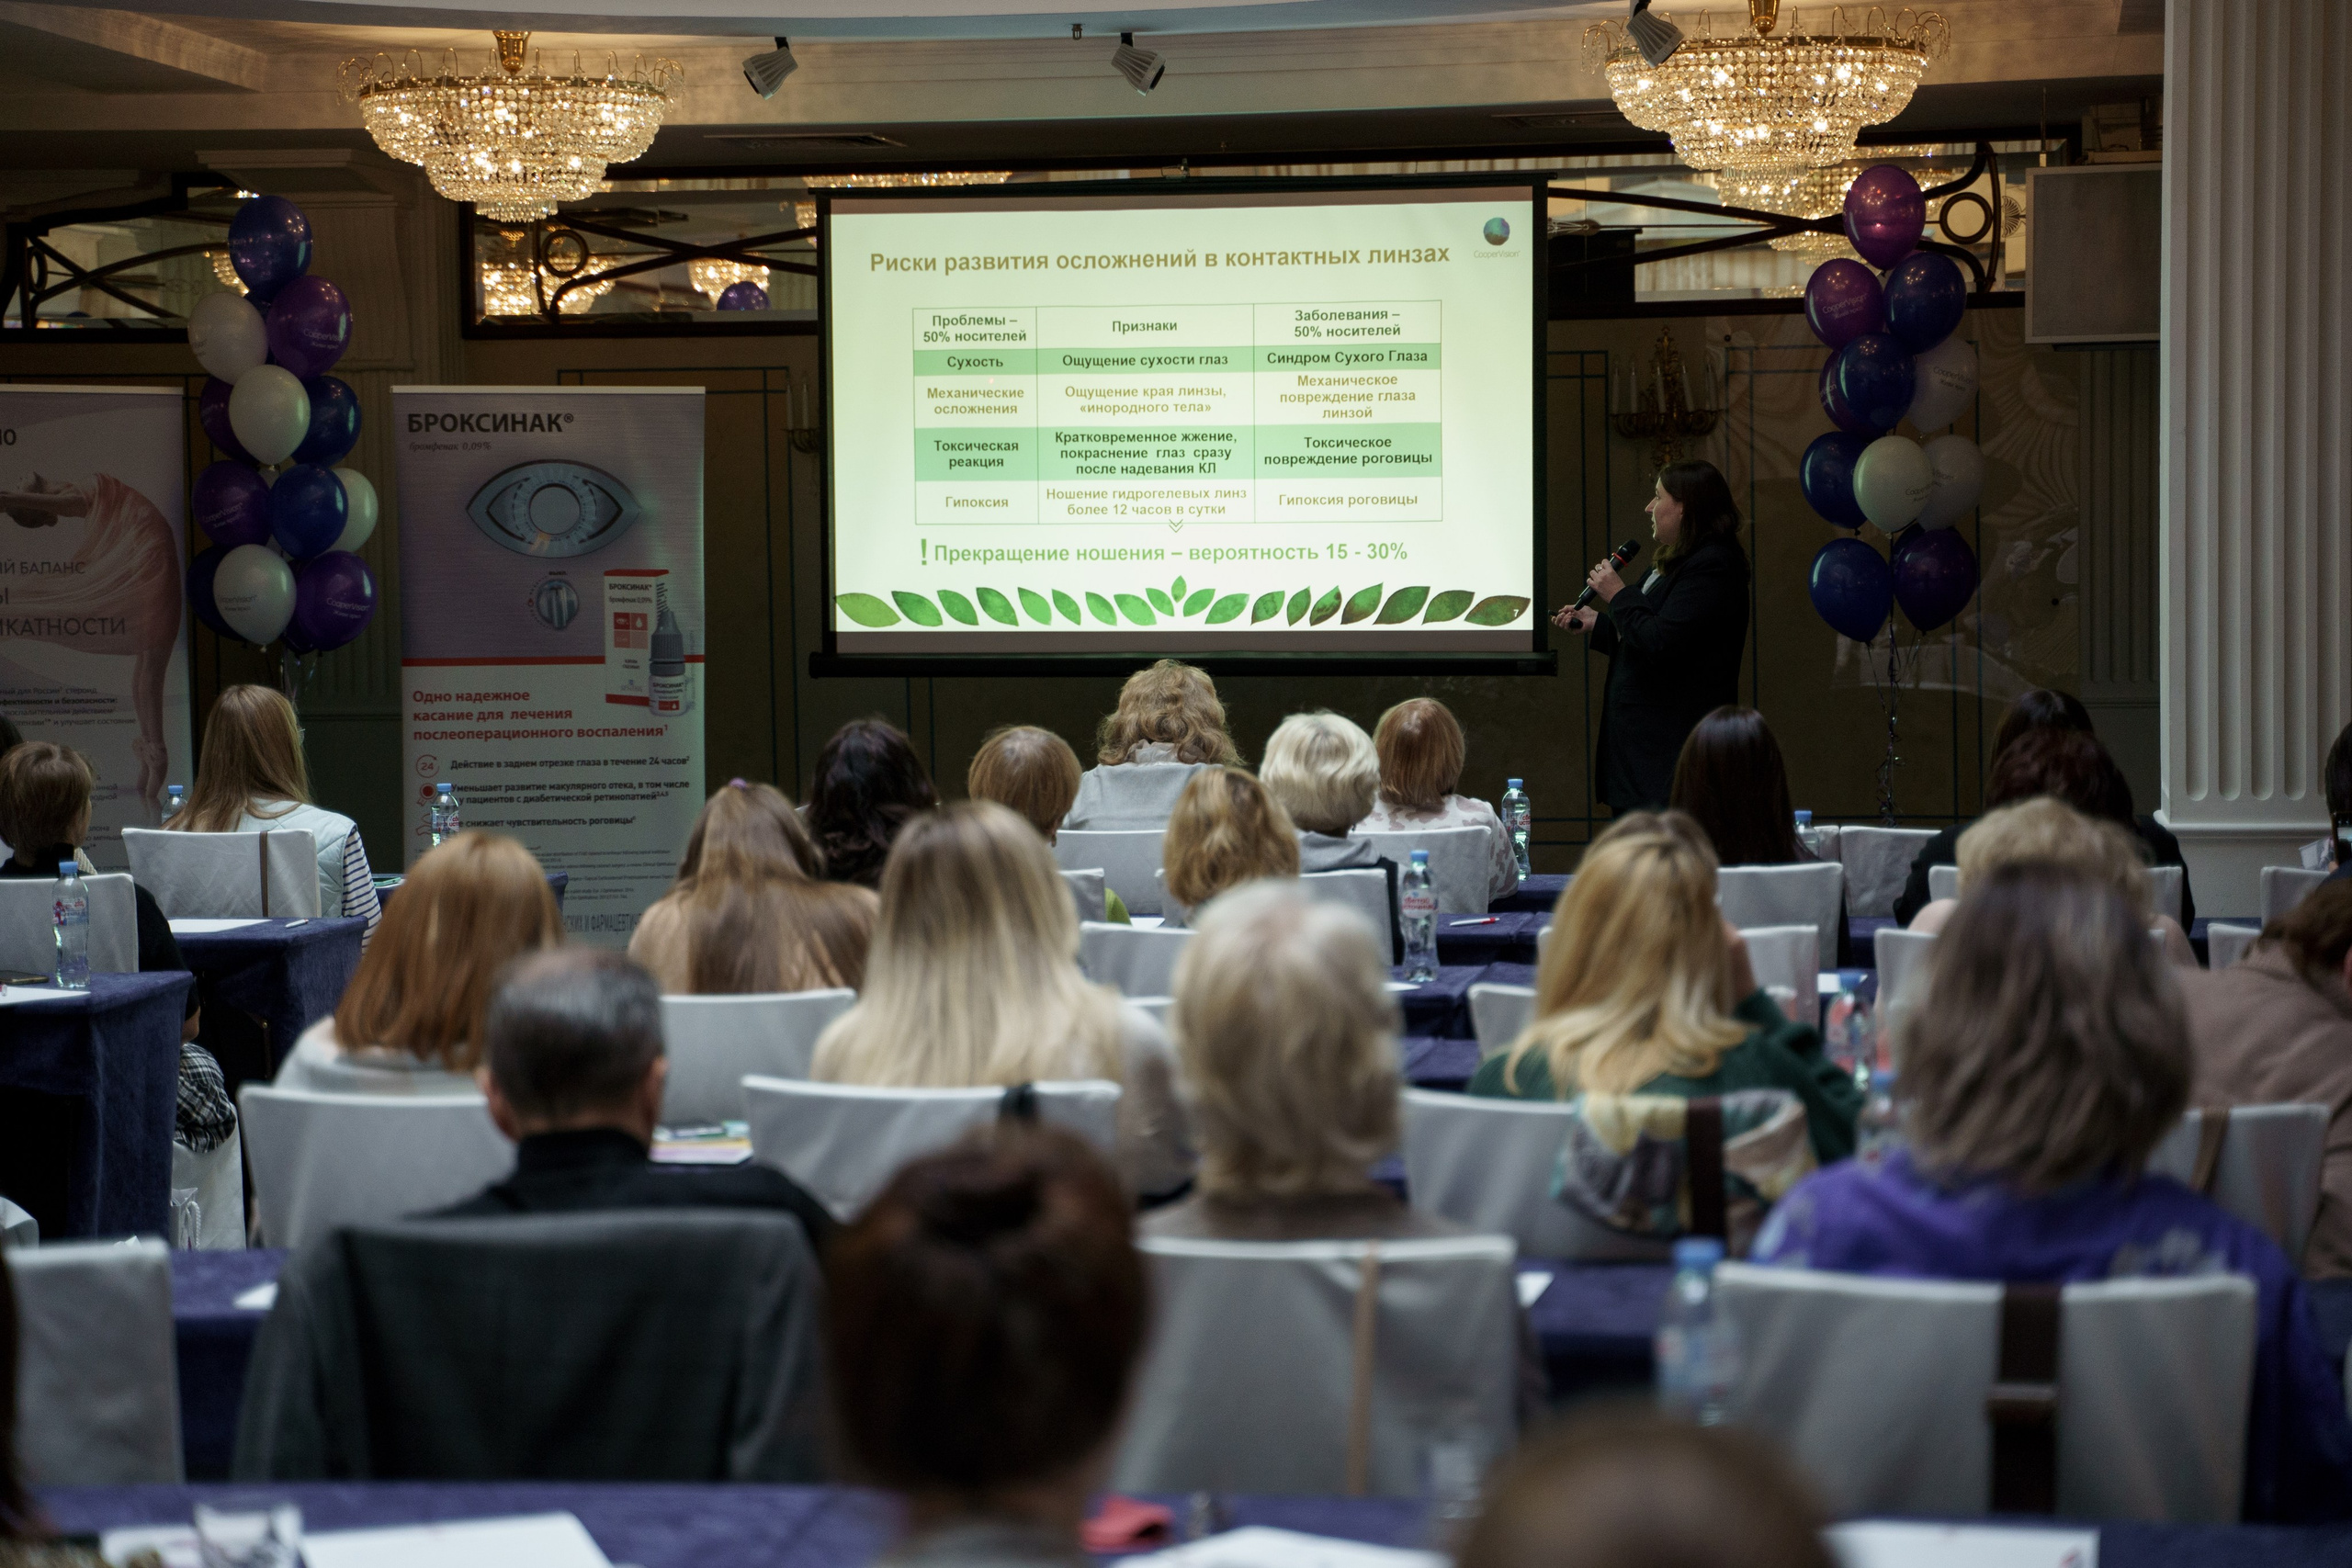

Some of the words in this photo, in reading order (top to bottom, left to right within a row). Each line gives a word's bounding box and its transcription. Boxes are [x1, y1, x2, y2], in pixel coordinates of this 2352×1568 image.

[870, 253, 937, 272] Риски
[944, 254, 1049, 276] развития
[1056, 249, 1197, 270] осложнений
[1204, 253, 1218, 267] в
[1226, 249, 1361, 267] контактных
[1367, 247, 1450, 265] линзах
[932, 313, 1006, 330] Проблемы
[1295, 309, 1389, 321] Заболевания
[1112, 320, 1178, 335] Признаки
[1294, 325, 1322, 338] 50%
[1326, 323, 1401, 337] носителей
[922, 331, 951, 344] 50%
[955, 330, 1027, 343] носителей
[946, 355, 1004, 371] Сухость
[1062, 354, 1136, 369] Ощущение
[1139, 355, 1195, 369] сухости
[1199, 355, 1228, 366] глаз
[1266, 352, 1331, 367] Синдром
[1334, 351, 1385, 367] Сухого
[1388, 349, 1428, 362] Глаза
[1297, 374, 1398, 387] Механическое
[926, 387, 1024, 400] Механические
[1064, 385, 1139, 400] Ощущение
[1142, 387, 1174, 400] края
[1178, 387, 1227, 398] линзы,
[1279, 392, 1373, 406] повреждение
[1377, 391, 1417, 402] глаза
[933, 404, 1018, 415] осложнения
[1080, 403, 1170, 417] «инородного
[1172, 402, 1212, 412] тела»
[1322, 406, 1374, 419] линзой
[933, 439, 1019, 452] Токсическая
[1055, 431, 1178, 446] Кратковременное
[1181, 433, 1238, 444] жжение,
[1304, 436, 1393, 448] Токсическое
[462, 442, 492, 450] 0,09%
[1059, 449, 1148, 462] покраснение
[1156, 448, 1186, 458] глаз
[1193, 448, 1232, 461] сразу
[1263, 455, 1358, 468] повреждение
[1362, 454, 1433, 468] роговицы
[948, 457, 1004, 470] реакция
[1076, 465, 1117, 475] после
[1120, 465, 1194, 477] надевания
[1198, 461, 1216, 474] КЛ
[945, 495, 1009, 508] Гипоксия
[1046, 488, 1109, 501] Ношение
[1112, 490, 1210, 502] гидрогелевых
[1214, 489, 1248, 499] линз
[1278, 493, 1344, 506] Гипоксия
[1348, 495, 1419, 508] роговицы
[1067, 503, 1109, 515] более
[1113, 502, 1128, 515] 12
[1131, 505, 1172, 515] часов
[1176, 505, 1184, 515] в
[1188, 505, 1227, 518] сутки
[934, 544, 1070, 566] Прекращение
[1076, 547, 1165, 561] ношения
[1189, 547, 1319, 565] вероятность
[1326, 543, 1349, 560] 15
[1367, 542, 1408, 560] 30%
[20, 561, 86, 575] БАЛАНС
[1511, 608, 1521, 620] 7
[65, 687, 98, 695] стероид
[413, 691, 452, 704] Одно
[456, 691, 530, 702] надежное
[61, 718, 96, 728] улучшает
[413, 711, 473, 721] касание
[477, 711, 503, 723] для
[510, 709, 572, 720] лечения
[413, 728, 573, 742] послеоперационного
[451, 760, 494, 770] Действие
[504, 761, 537, 769] заднем
[539, 760, 574, 768] отрезке
[611, 758, 647, 766] течение
[649, 757, 660, 765] 24
[451, 784, 503, 793] Уменьшает
[504, 783, 547, 793] развитие
[549, 783, 606, 792] макулярного
[608, 782, 636, 791] отека,
[458, 797, 464, 807] у
[467, 795, 514, 806] пациентов
[523, 793, 592, 803] диабетической
[466, 818, 503, 827] снижает
[506, 816, 587, 827] чувствительность
